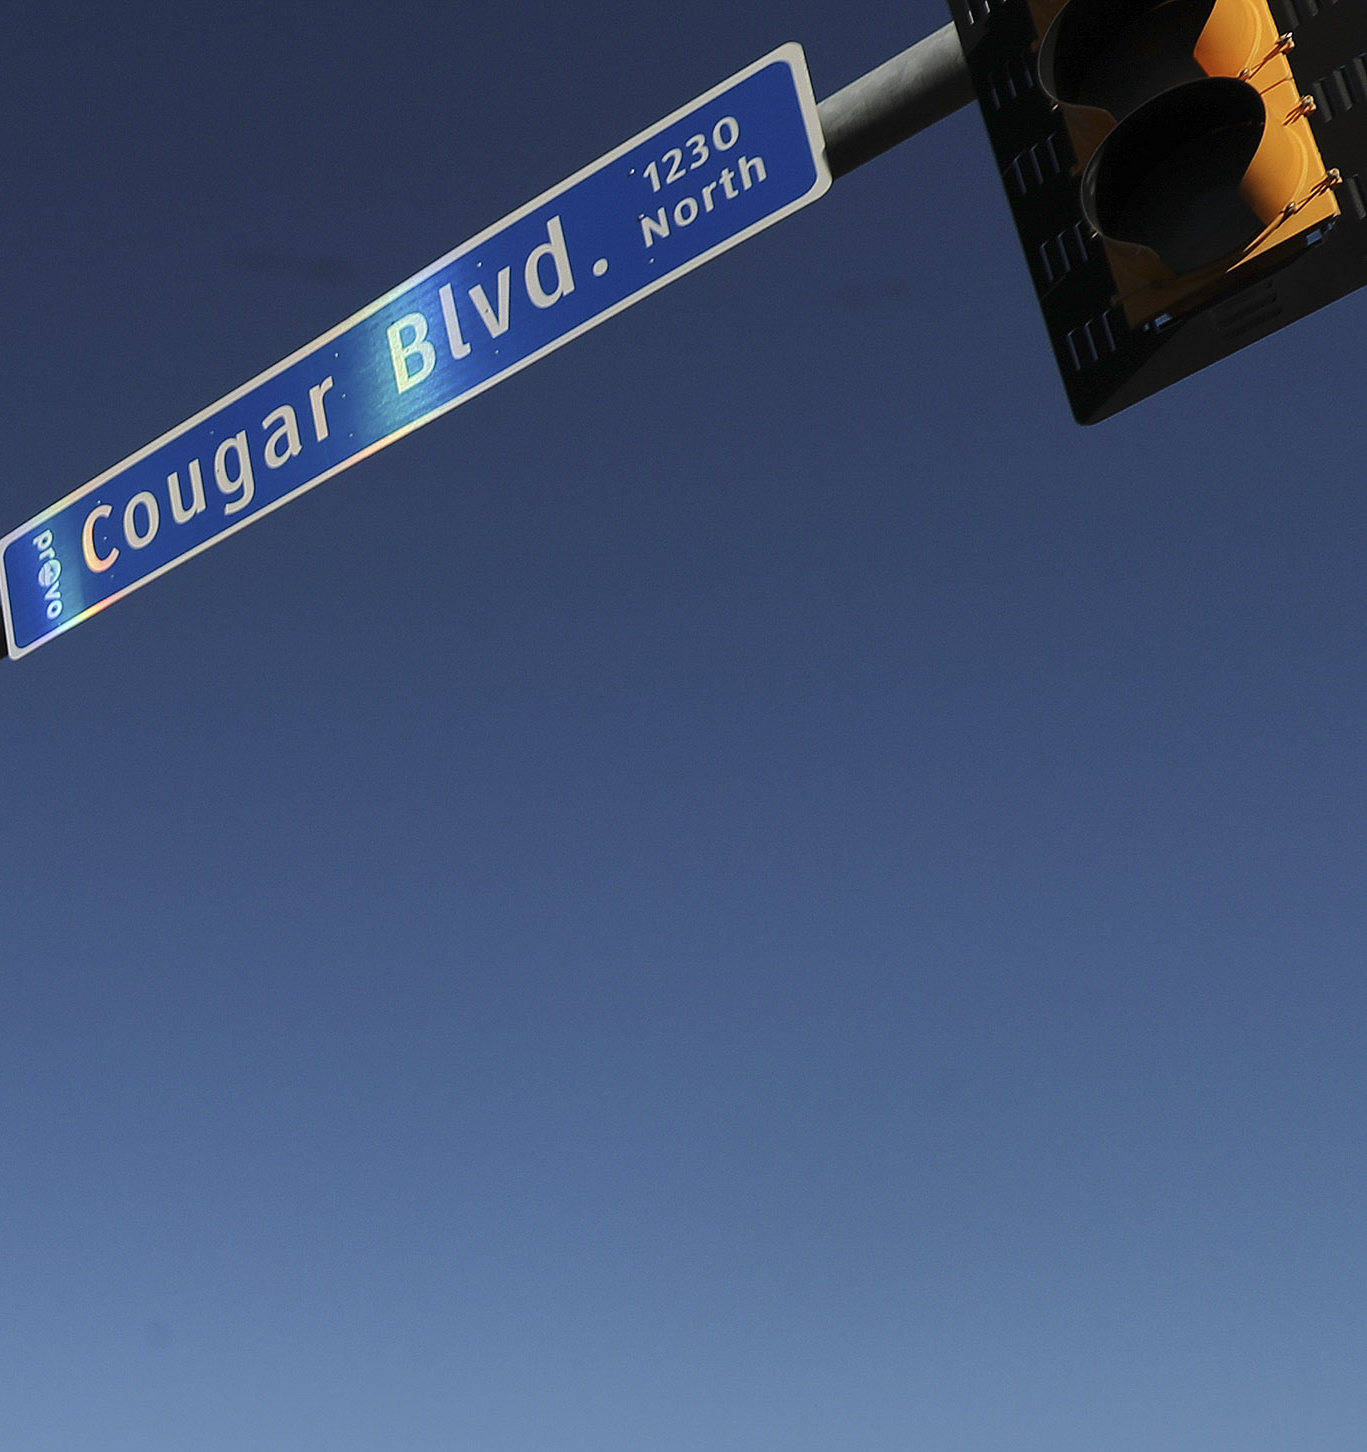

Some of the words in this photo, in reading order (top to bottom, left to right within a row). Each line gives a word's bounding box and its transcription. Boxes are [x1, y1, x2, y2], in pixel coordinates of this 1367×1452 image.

[639, 154, 768, 248] North
[642, 116, 741, 193] 1230
[81, 375, 334, 573] Cougar
[384, 214, 609, 394] Blvd.
